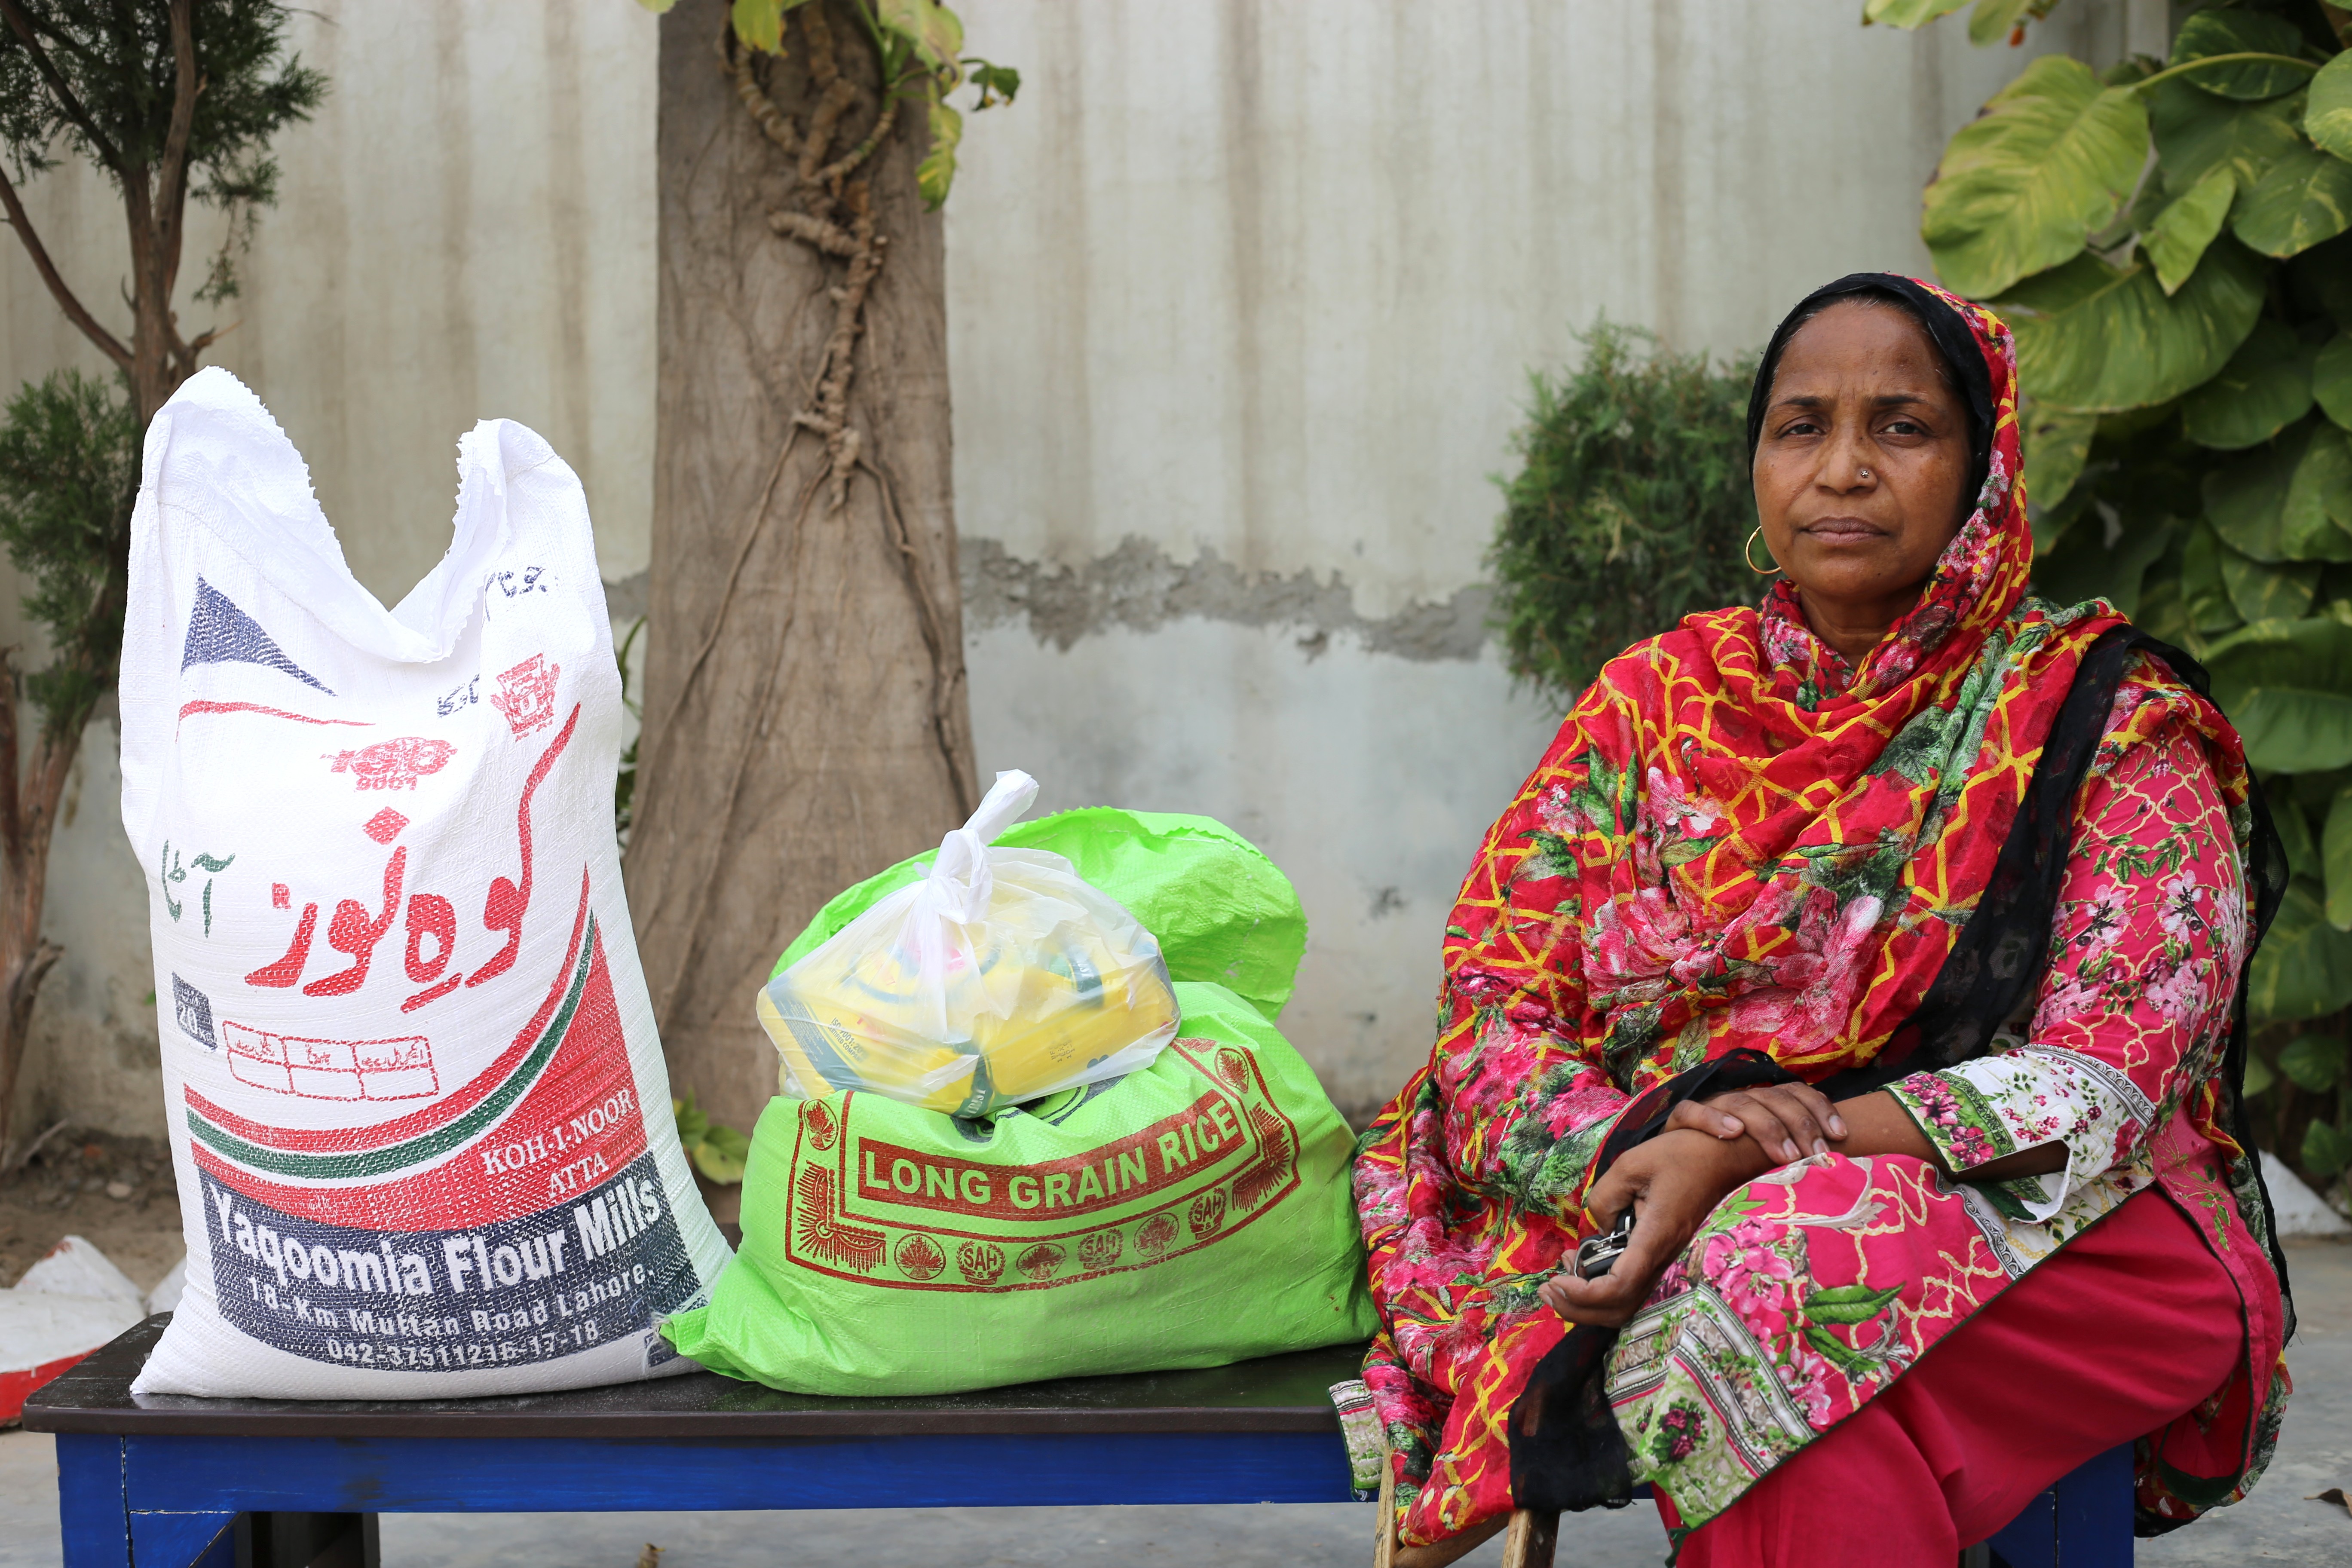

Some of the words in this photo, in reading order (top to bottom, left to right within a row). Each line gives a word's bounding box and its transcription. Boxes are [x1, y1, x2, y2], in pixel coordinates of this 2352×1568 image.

[356, 775, 418, 791] 9001
[865, 1150, 991, 1204] LONG
[1009, 1146, 1148, 1210] GRAIN
[1157, 1099, 1239, 1174] RICE
[549, 1152, 609, 1199] ATTA
[1194, 1195, 1222, 1222] SAH
[208, 1181, 433, 1295] Yaqoomia
[442, 1230, 565, 1293] Flour
[573, 1176, 661, 1261] Mills
[1084, 1234, 1116, 1257] SAH
[964, 1246, 997, 1271] SAH
[471, 1301, 549, 1332] Road
